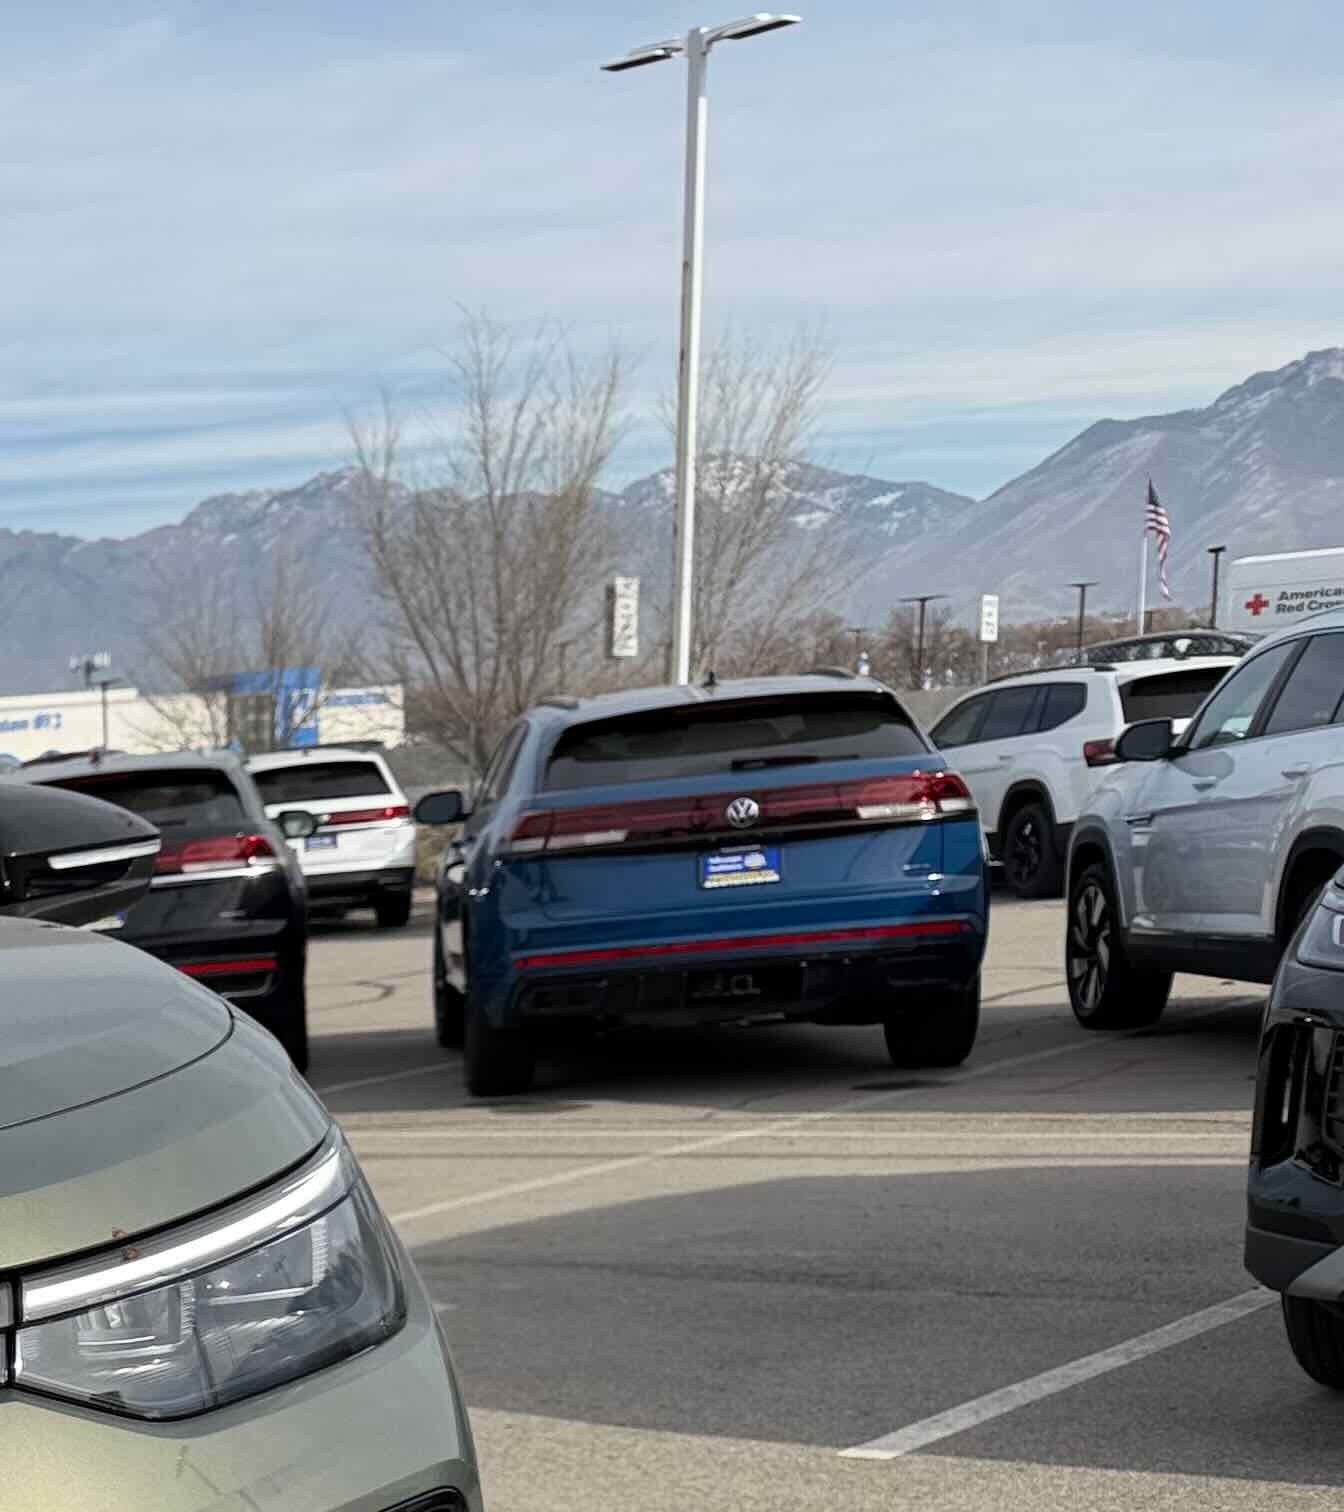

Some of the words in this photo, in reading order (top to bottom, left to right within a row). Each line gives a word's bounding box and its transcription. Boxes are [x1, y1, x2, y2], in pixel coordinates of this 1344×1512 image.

[1278, 586, 1344, 601] America
[1275, 601, 1305, 614] Red
[1307, 599, 1344, 611] Cro
